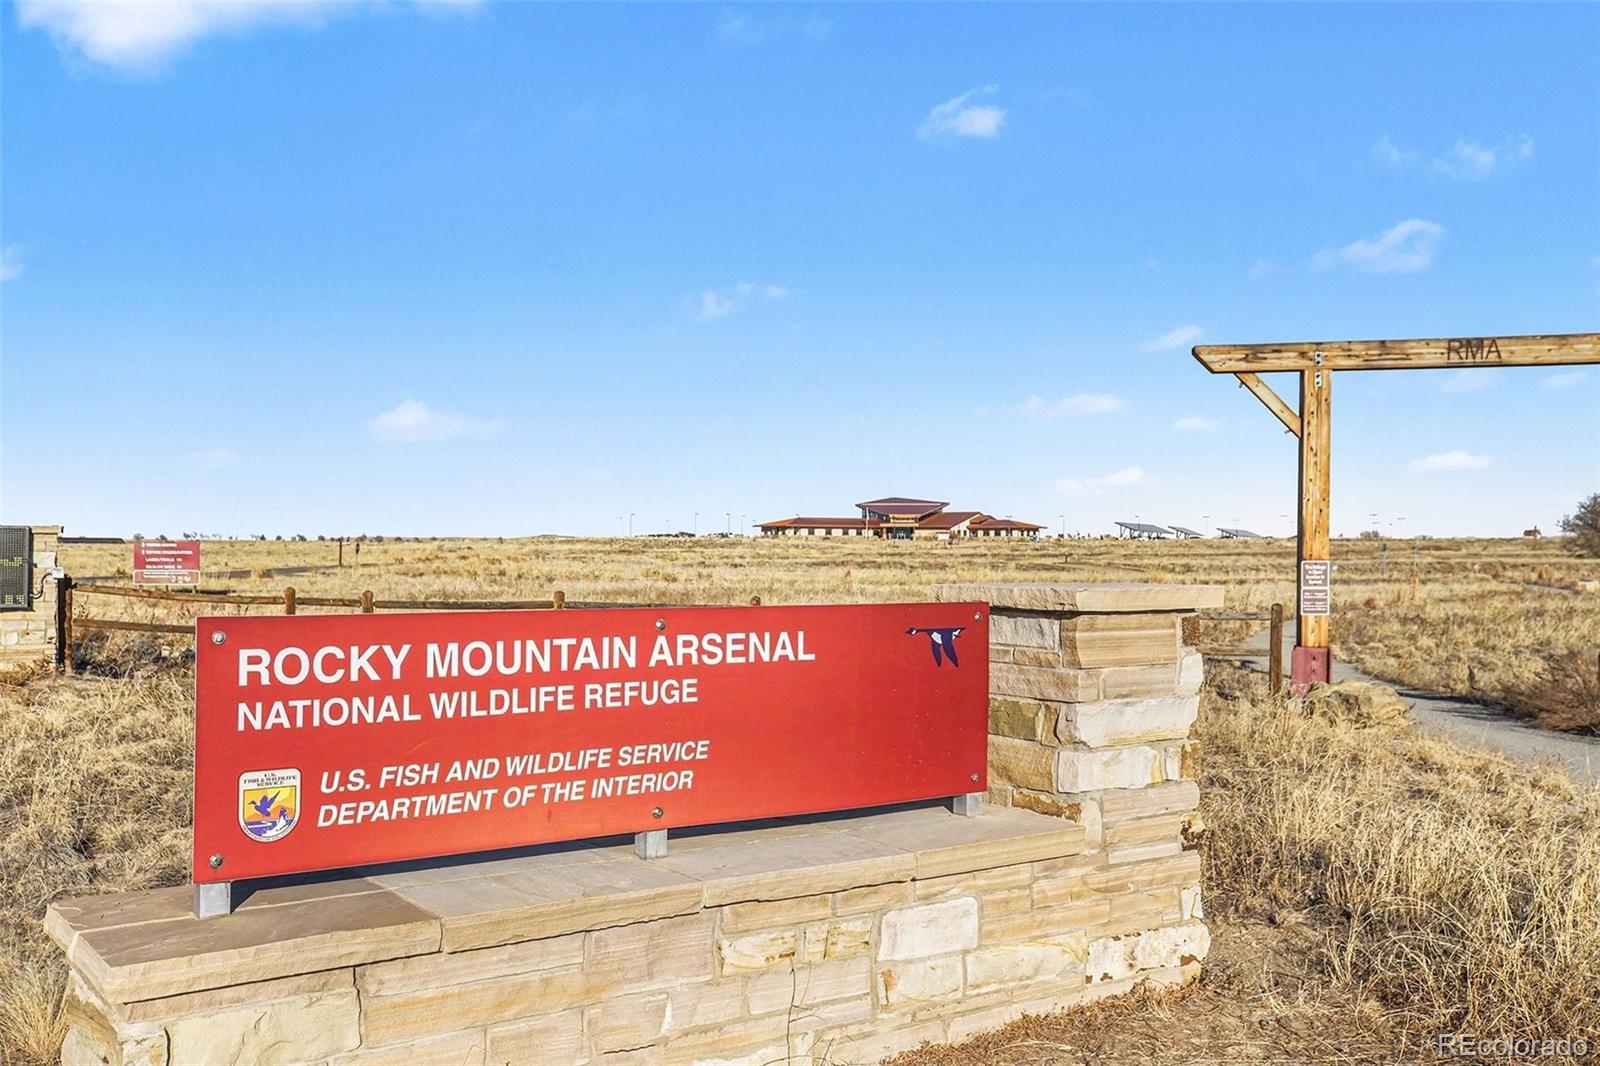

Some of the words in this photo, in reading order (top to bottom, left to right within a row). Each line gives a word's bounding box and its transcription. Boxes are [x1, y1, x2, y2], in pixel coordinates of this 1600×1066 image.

[1447, 339, 1502, 361] RMA
[238, 643, 411, 687] ROCKY
[426, 635, 637, 679] MOUNTAIN
[649, 630, 816, 667] ARSENAL
[237, 694, 422, 732] NATIONAL
[429, 685, 575, 720] WILDLIFE
[584, 678, 699, 709] REFUGE
[320, 769, 371, 794] U.S.
[379, 763, 440, 789] FISH
[444, 757, 501, 783] AND
[505, 747, 613, 779] WILDLIFE
[617, 739, 710, 768] SERVICE
[317, 788, 499, 828] DEPARTMENT
[502, 784, 538, 809] OF
[540, 779, 587, 804] THE
[590, 769, 694, 799] INTERIOR
